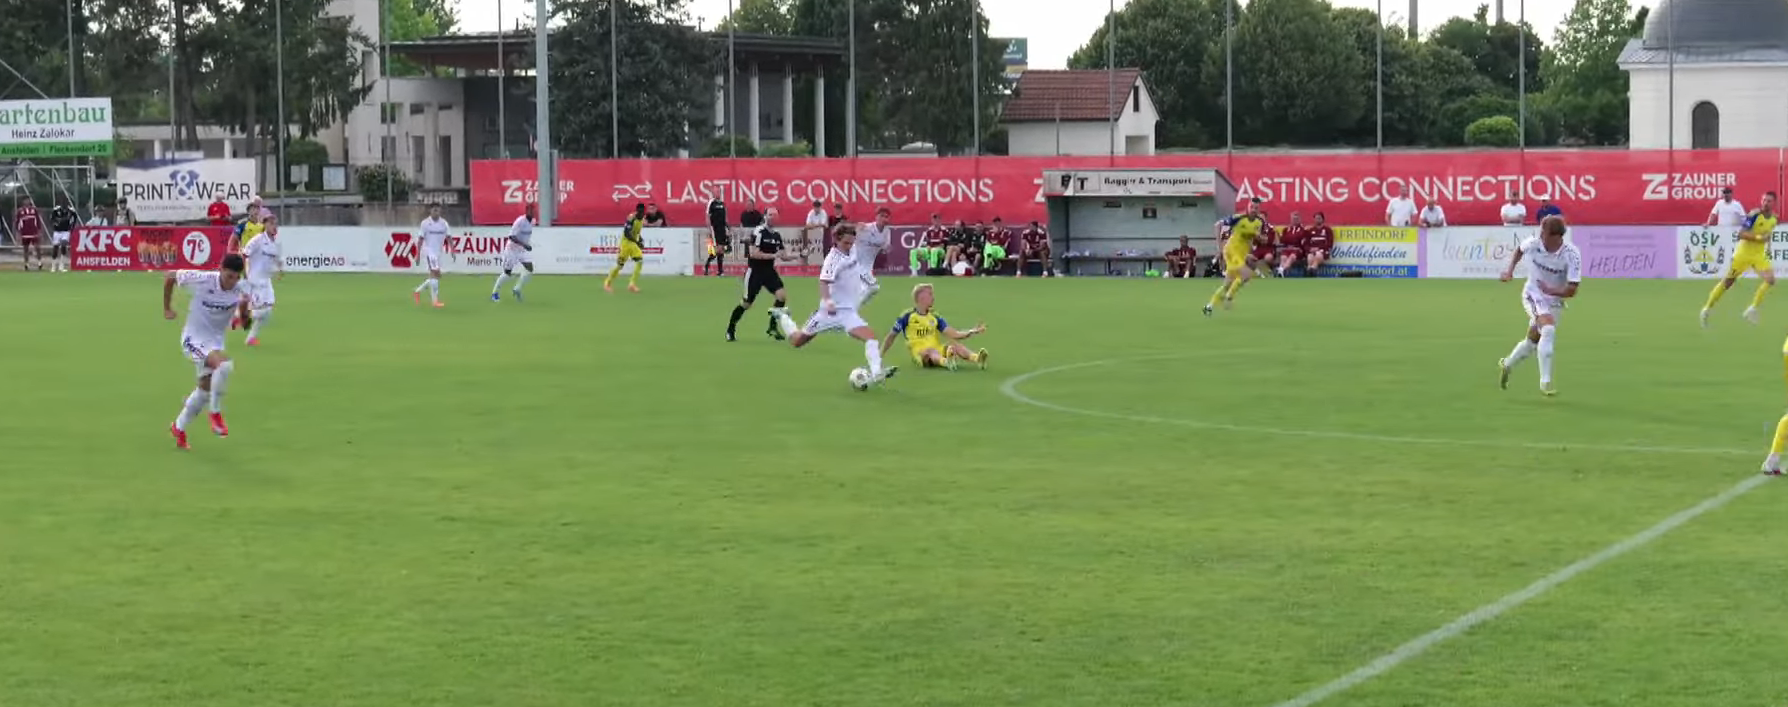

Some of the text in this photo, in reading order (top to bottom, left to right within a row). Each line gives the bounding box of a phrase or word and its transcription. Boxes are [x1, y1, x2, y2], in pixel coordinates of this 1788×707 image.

[0, 102, 106, 124] artenbau
[11, 128, 75, 139] Heinz Zalokar
[1147, 177, 1192, 186] Transport
[1672, 173, 1737, 186] ZAUNER
[122, 183, 174, 200] PRINT
[195, 182, 250, 200] WEAR
[667, 179, 993, 203] LASTING CONNECTIONS
[1235, 176, 1596, 202] ASTING CONNECTIONS
[76, 230, 131, 252] KFC
[76, 257, 130, 266] ANSFELDEN
